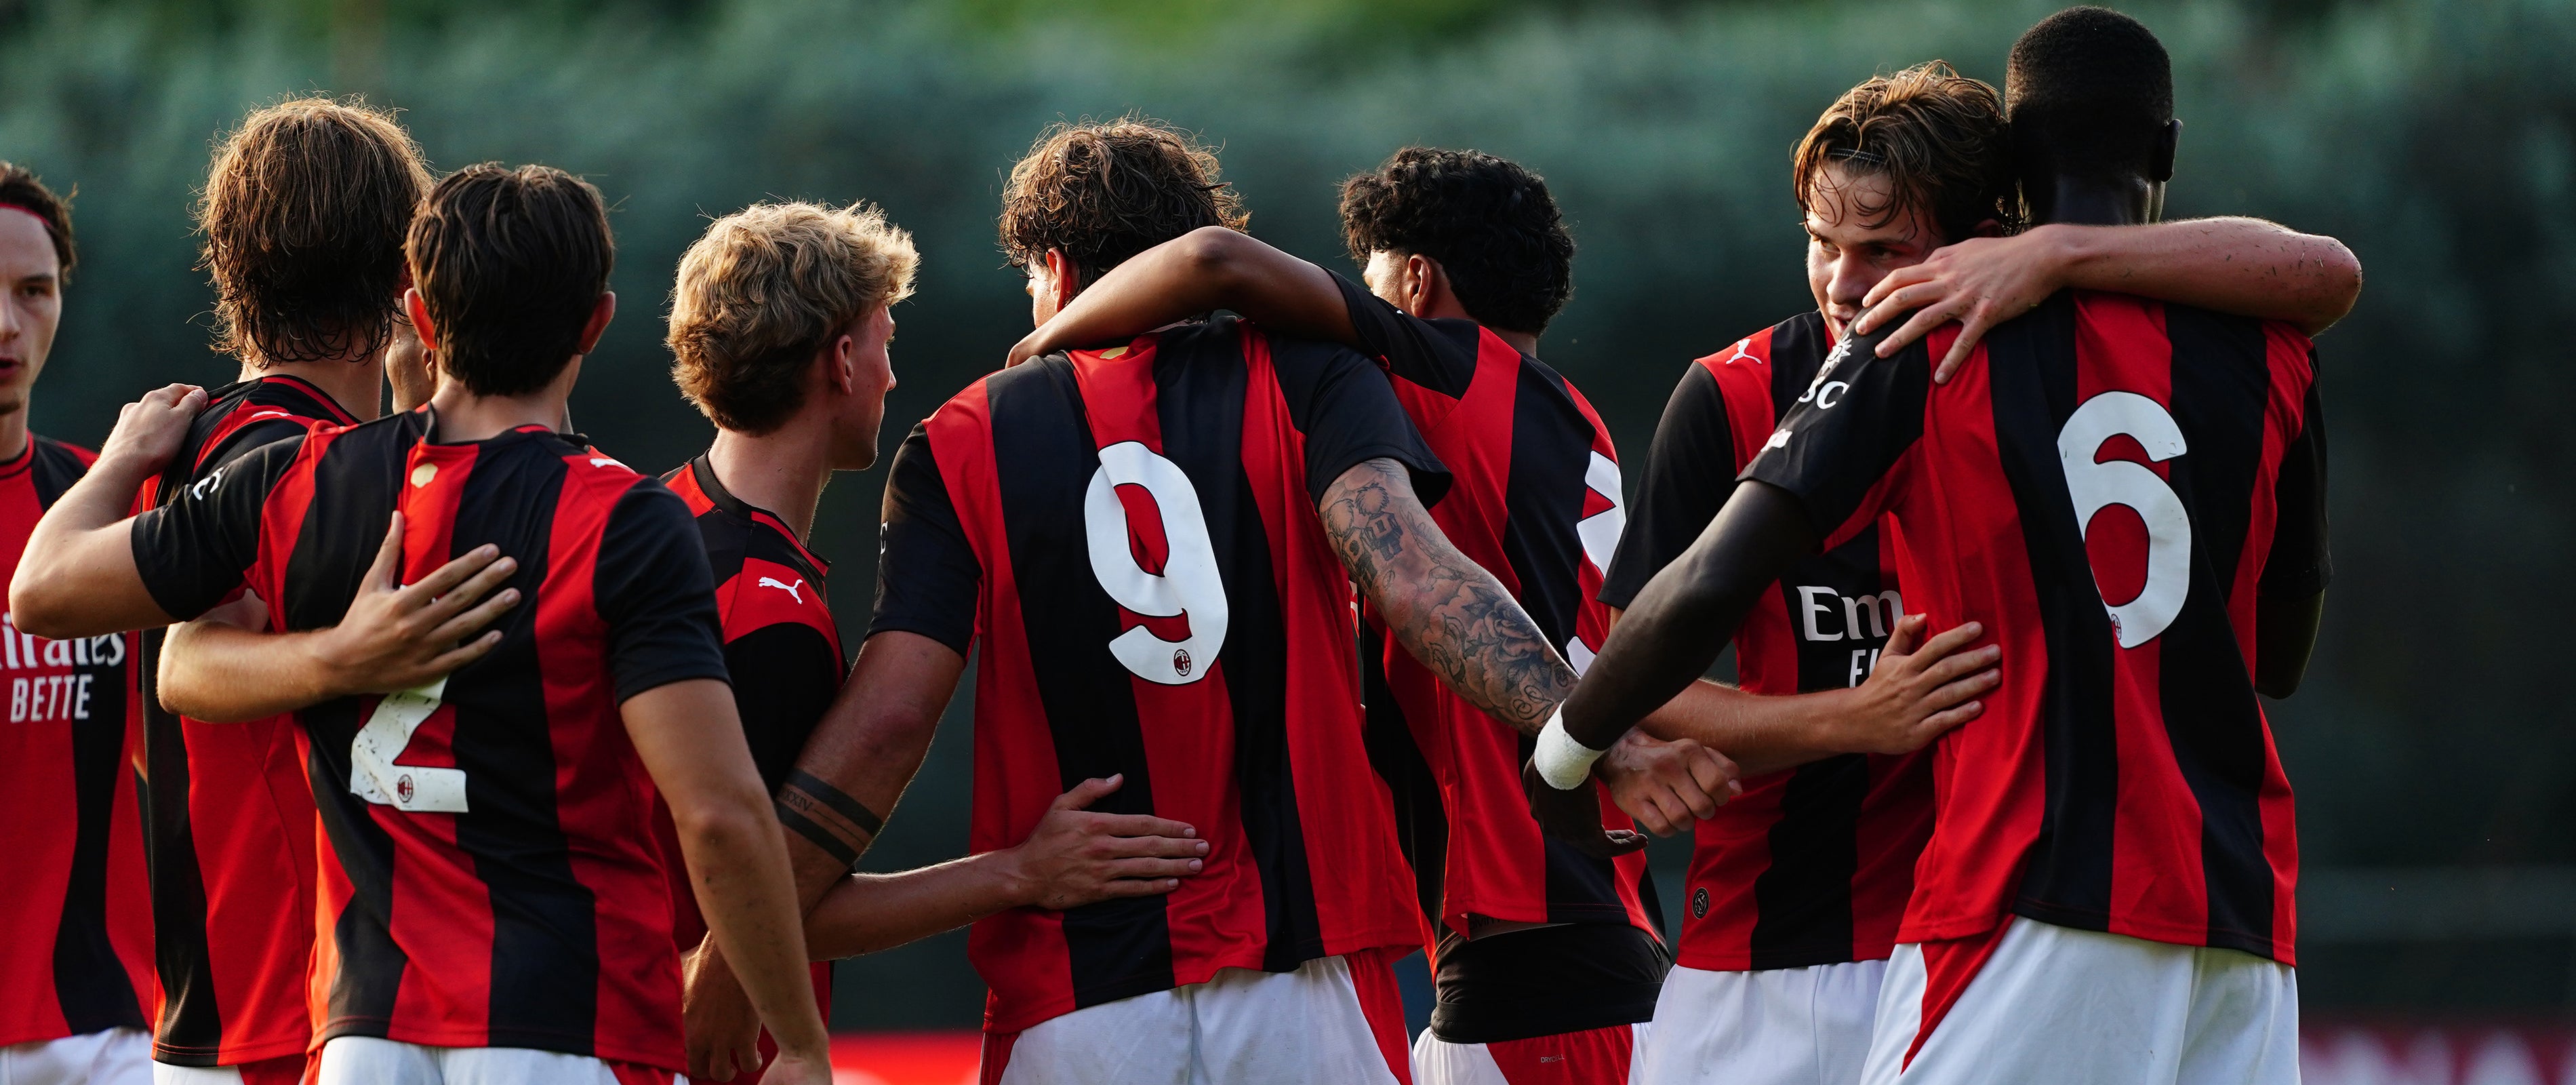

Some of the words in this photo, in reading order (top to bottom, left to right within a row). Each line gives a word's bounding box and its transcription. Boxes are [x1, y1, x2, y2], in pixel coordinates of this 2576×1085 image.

[2057, 390, 2191, 649] 6
[1084, 441, 1228, 685] 9
[0, 612, 125, 669] irates
[10, 673, 94, 723] BETTE
[1540, 1053, 1565, 1063] DRYCELL
